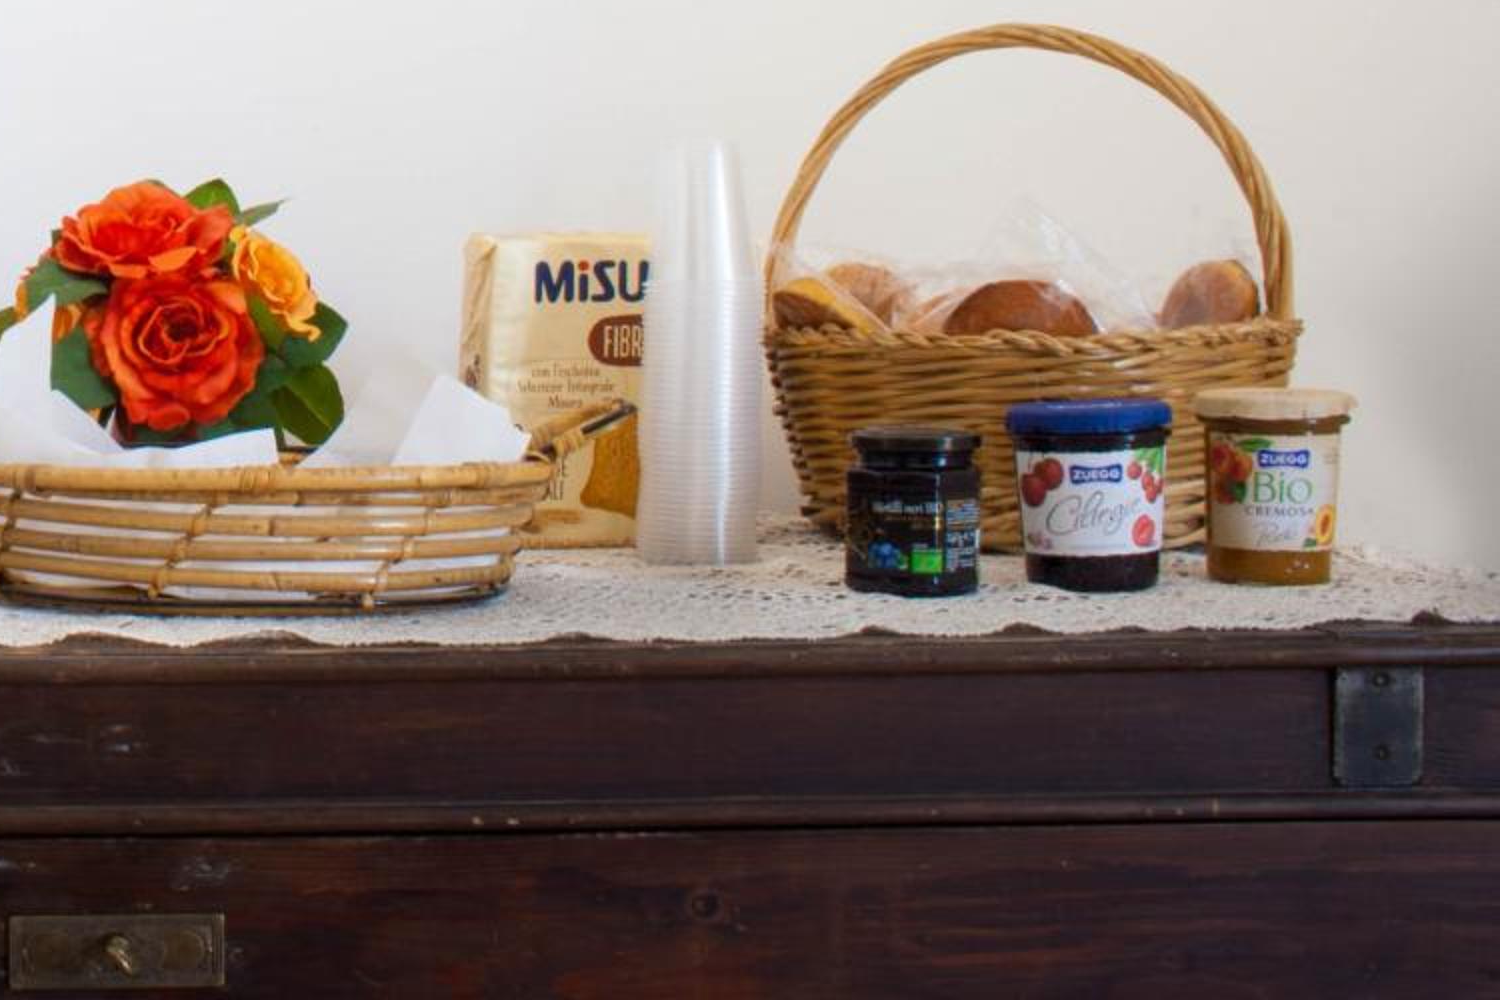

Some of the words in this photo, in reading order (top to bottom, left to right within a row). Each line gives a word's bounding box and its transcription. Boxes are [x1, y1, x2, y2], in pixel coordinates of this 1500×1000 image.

[1260, 452, 1306, 464] ZUEGG
[1072, 468, 1120, 480] ZUEGG
[1253, 471, 1313, 505] Bio
